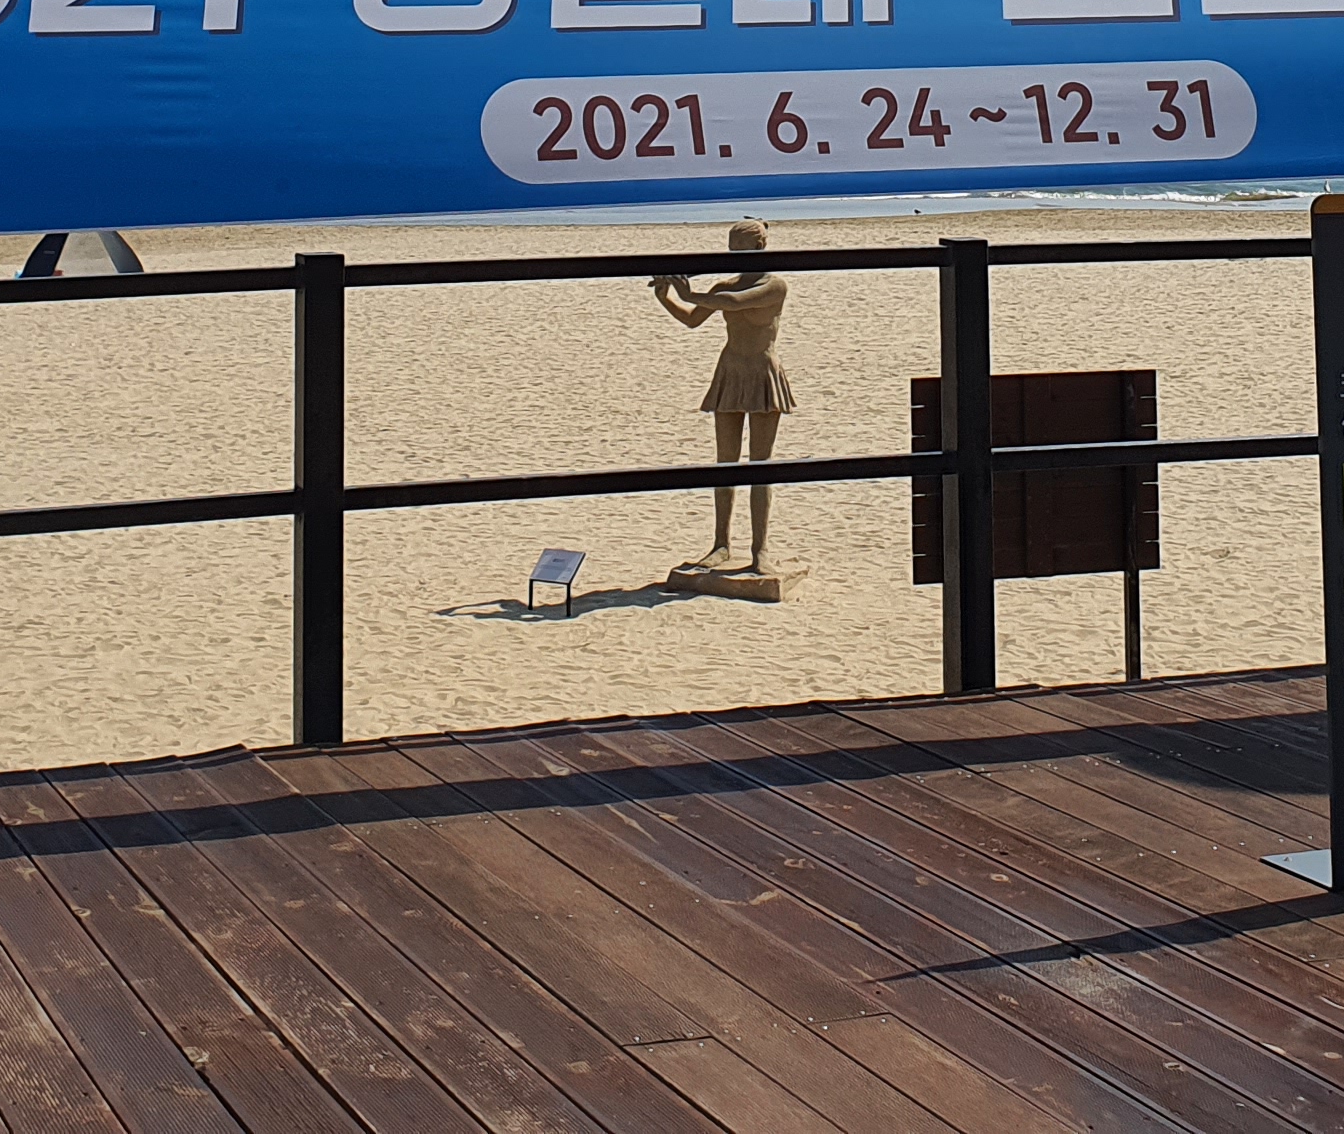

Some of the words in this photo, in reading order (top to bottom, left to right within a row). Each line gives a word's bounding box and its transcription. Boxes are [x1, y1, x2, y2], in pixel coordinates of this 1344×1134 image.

[532, 93, 733, 162] 2021.
[766, 91, 831, 155] 6.
[1146, 79, 1217, 140] 31
